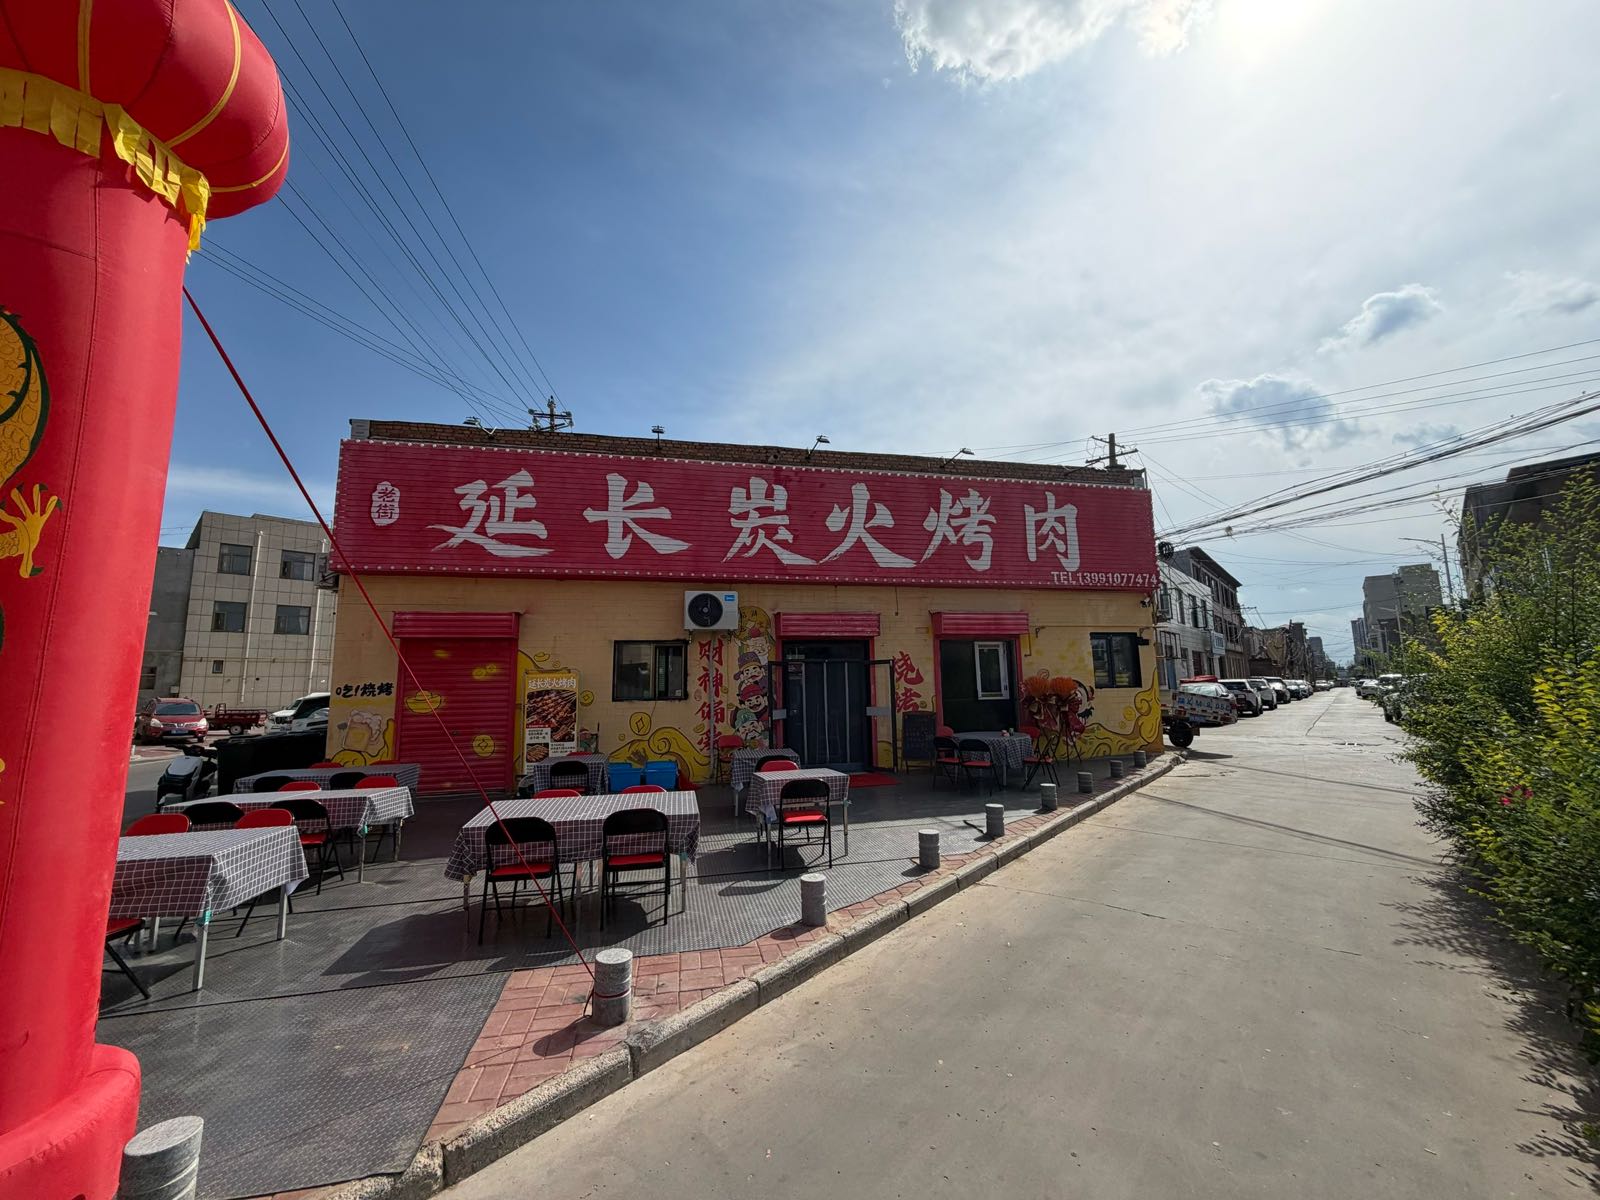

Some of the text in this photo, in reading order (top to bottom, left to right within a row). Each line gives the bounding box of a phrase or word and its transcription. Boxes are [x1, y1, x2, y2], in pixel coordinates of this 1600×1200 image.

[377, 486, 396, 519] 老街
[427, 467, 1080, 572] 延长炭火烤肉
